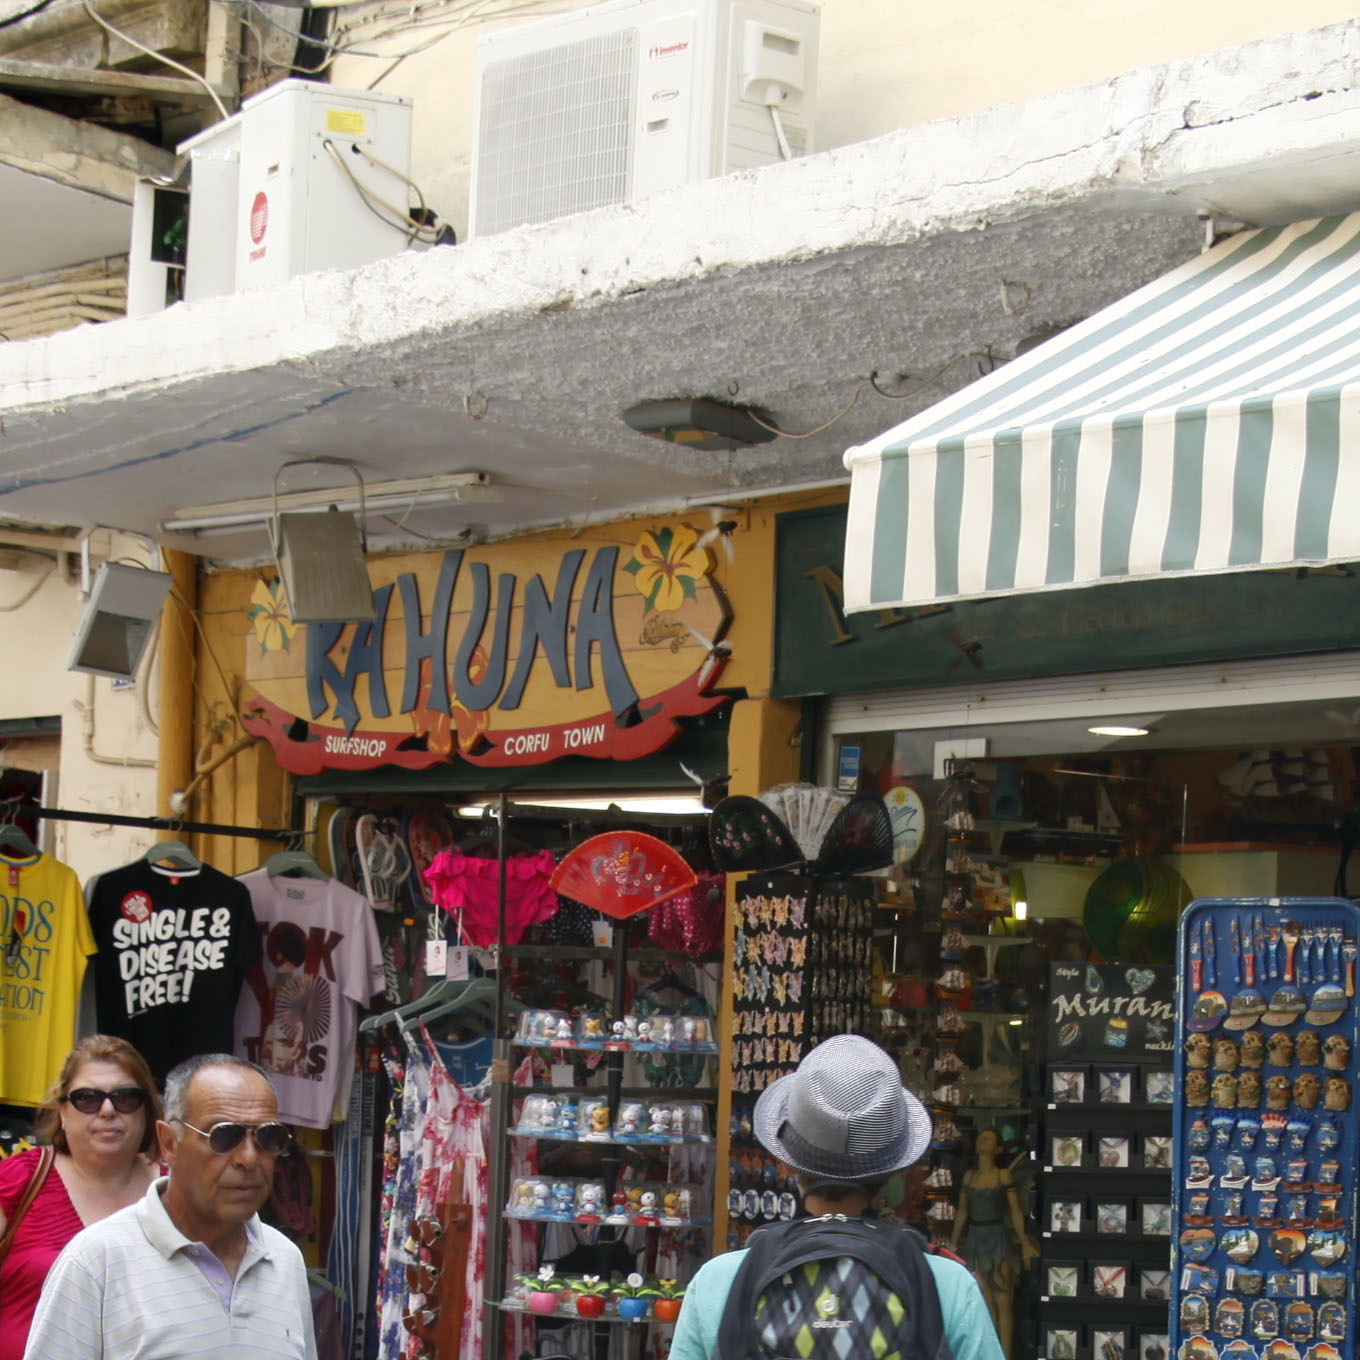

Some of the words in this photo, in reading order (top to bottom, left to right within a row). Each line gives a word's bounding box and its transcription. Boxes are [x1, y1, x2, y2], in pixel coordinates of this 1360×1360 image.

[305, 545, 640, 740] KAHUNA
[324, 734, 387, 758] SURFSHOP
[503, 732, 550, 756] CORFU
[563, 724, 606, 750] TOWN
[112, 907, 210, 949] SINGLE
[209, 906, 231, 938] &
[119, 939, 229, 981] DISEASE
[1056, 967, 1080, 980] Style
[125, 969, 195, 1015] FREE!
[1052, 992, 1177, 1024] Muran
[812, 1318, 854, 1329] deuter
